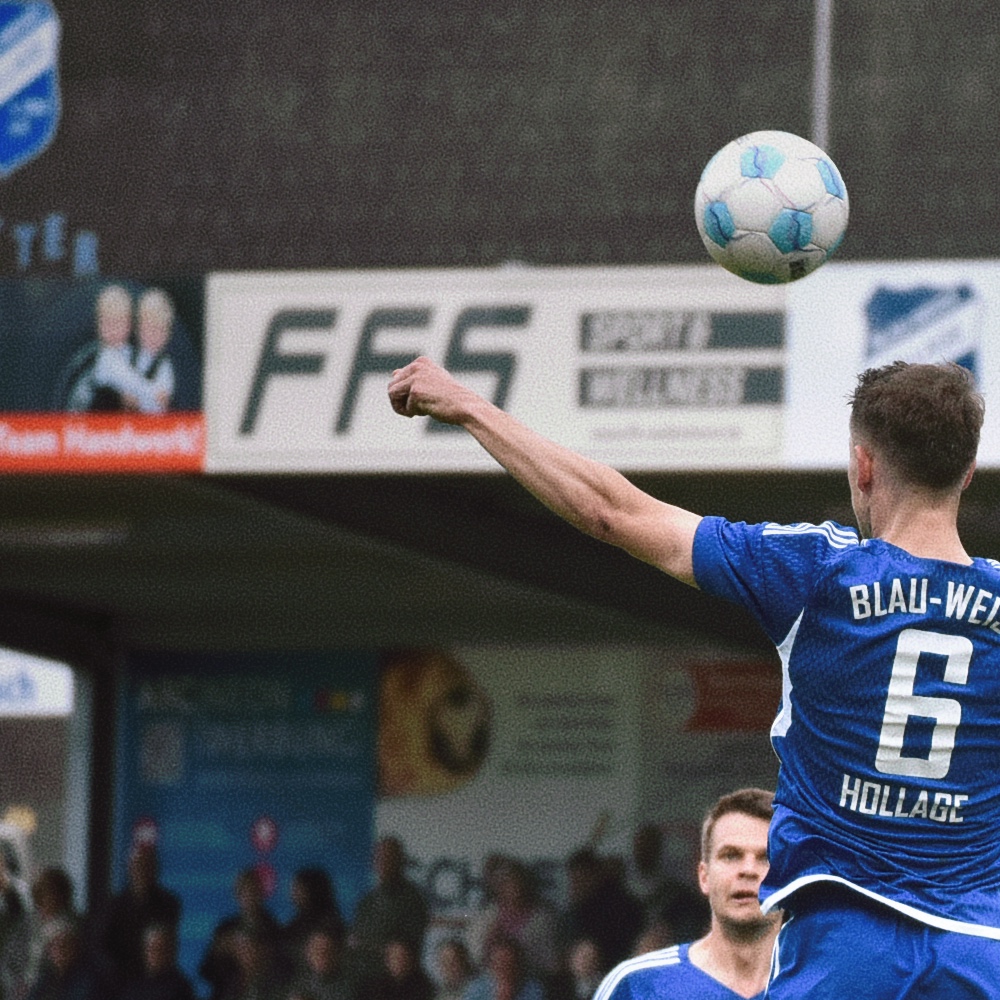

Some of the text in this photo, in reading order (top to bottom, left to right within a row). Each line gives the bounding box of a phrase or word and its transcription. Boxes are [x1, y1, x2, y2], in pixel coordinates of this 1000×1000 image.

[238, 305, 532, 435] FFS
[875, 628, 973, 779] 6
[839, 774, 968, 823] HOLLAGE
